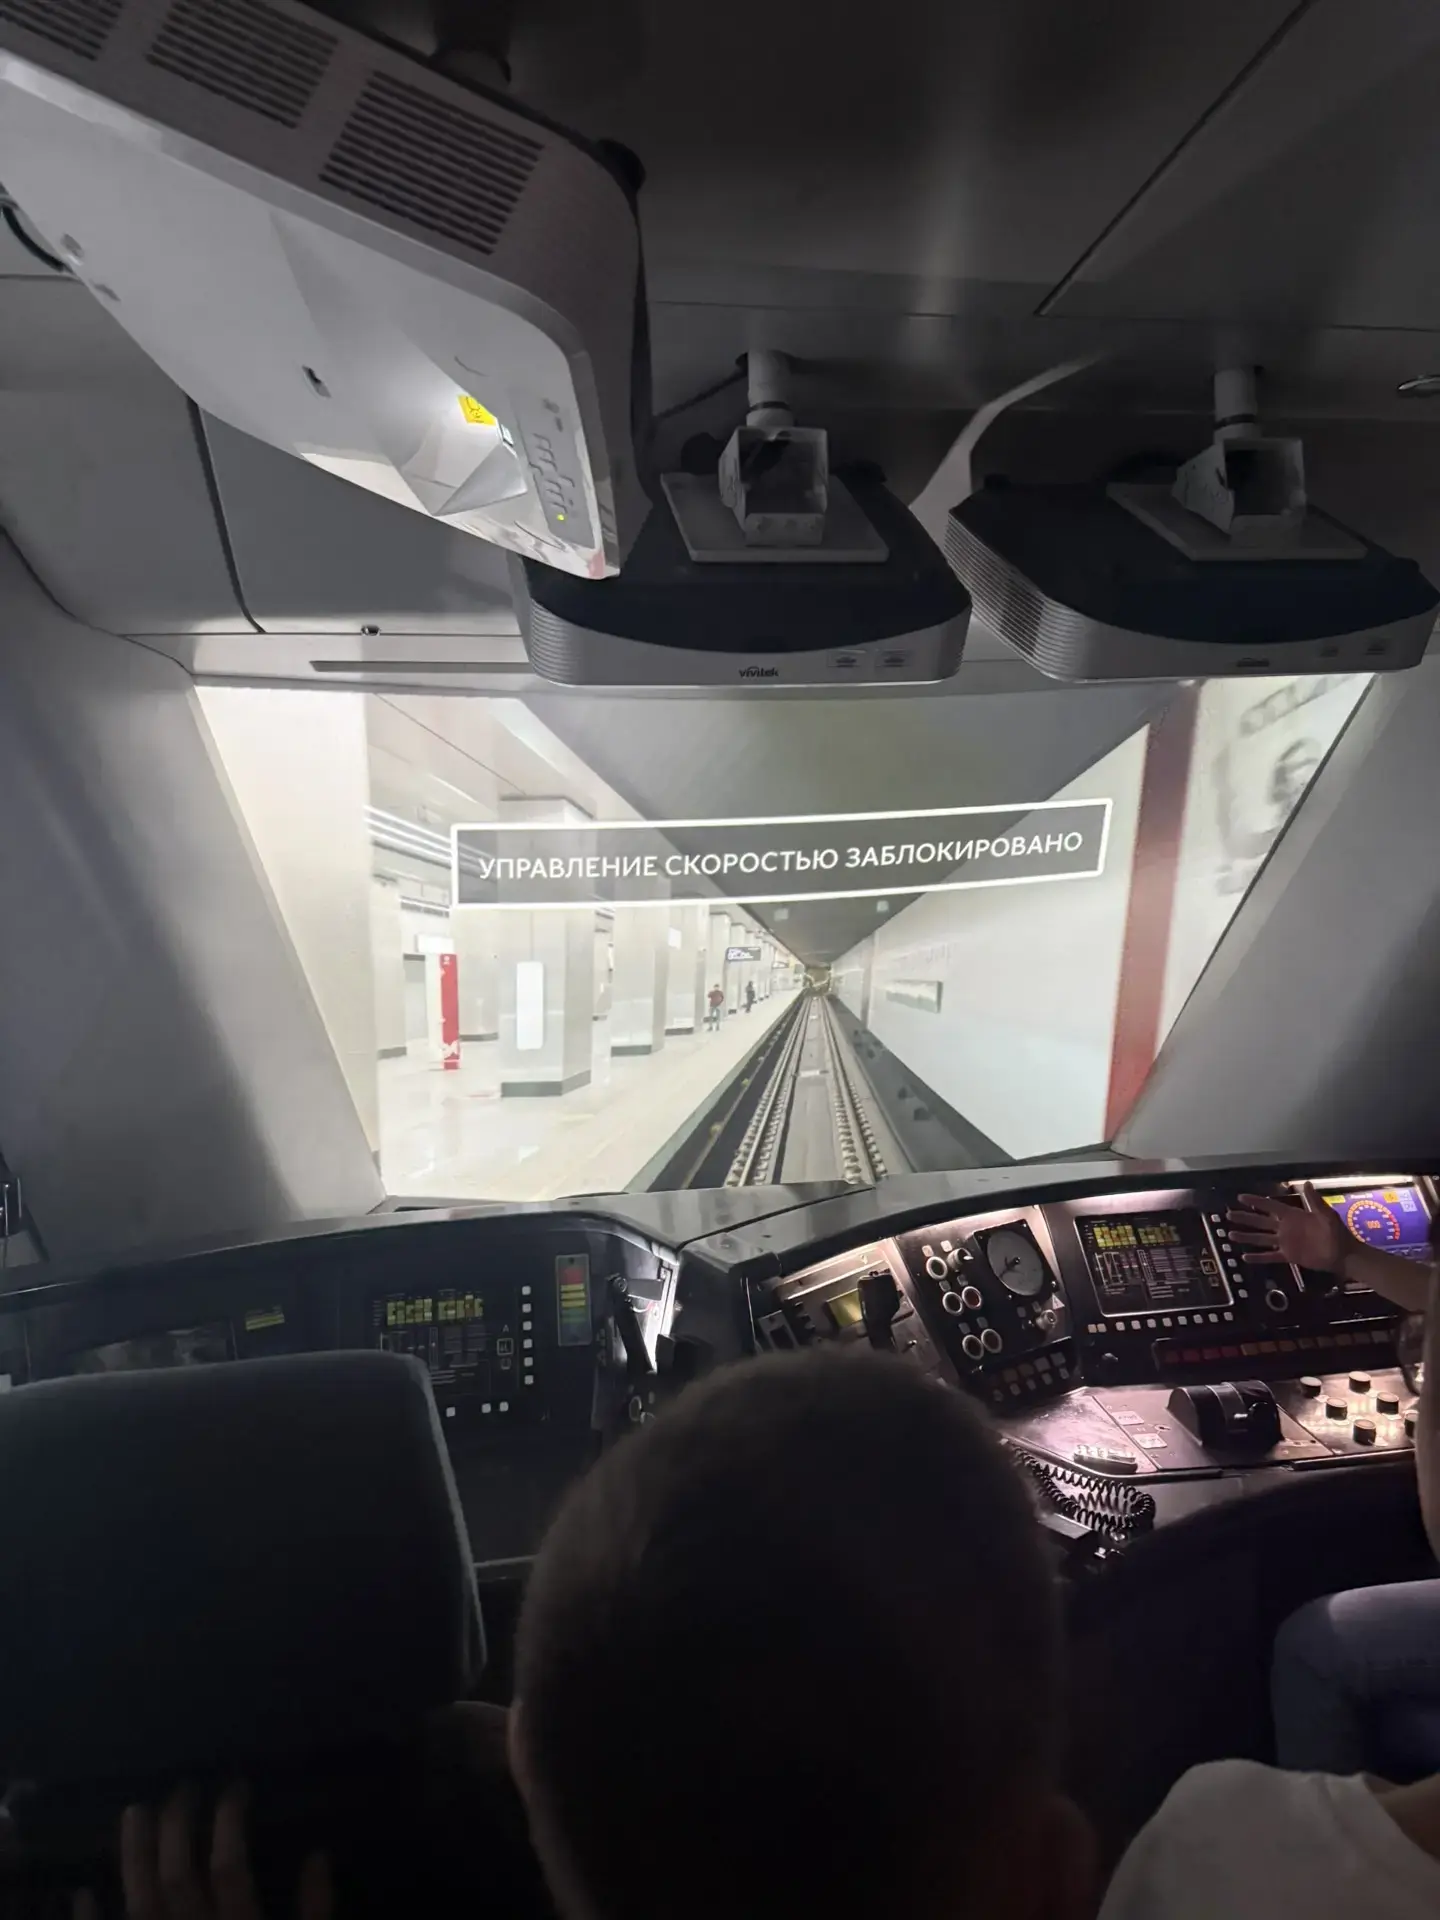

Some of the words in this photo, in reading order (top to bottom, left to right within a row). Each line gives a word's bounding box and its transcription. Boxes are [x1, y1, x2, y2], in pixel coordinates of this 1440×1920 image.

[738, 666, 779, 678] vivitek
[478, 855, 658, 880] УПРАВЛЕНИЕ
[664, 848, 839, 876] СКОРОСТЬЮ
[845, 831, 1084, 869] ЗАБЛОКИРОВАНО
